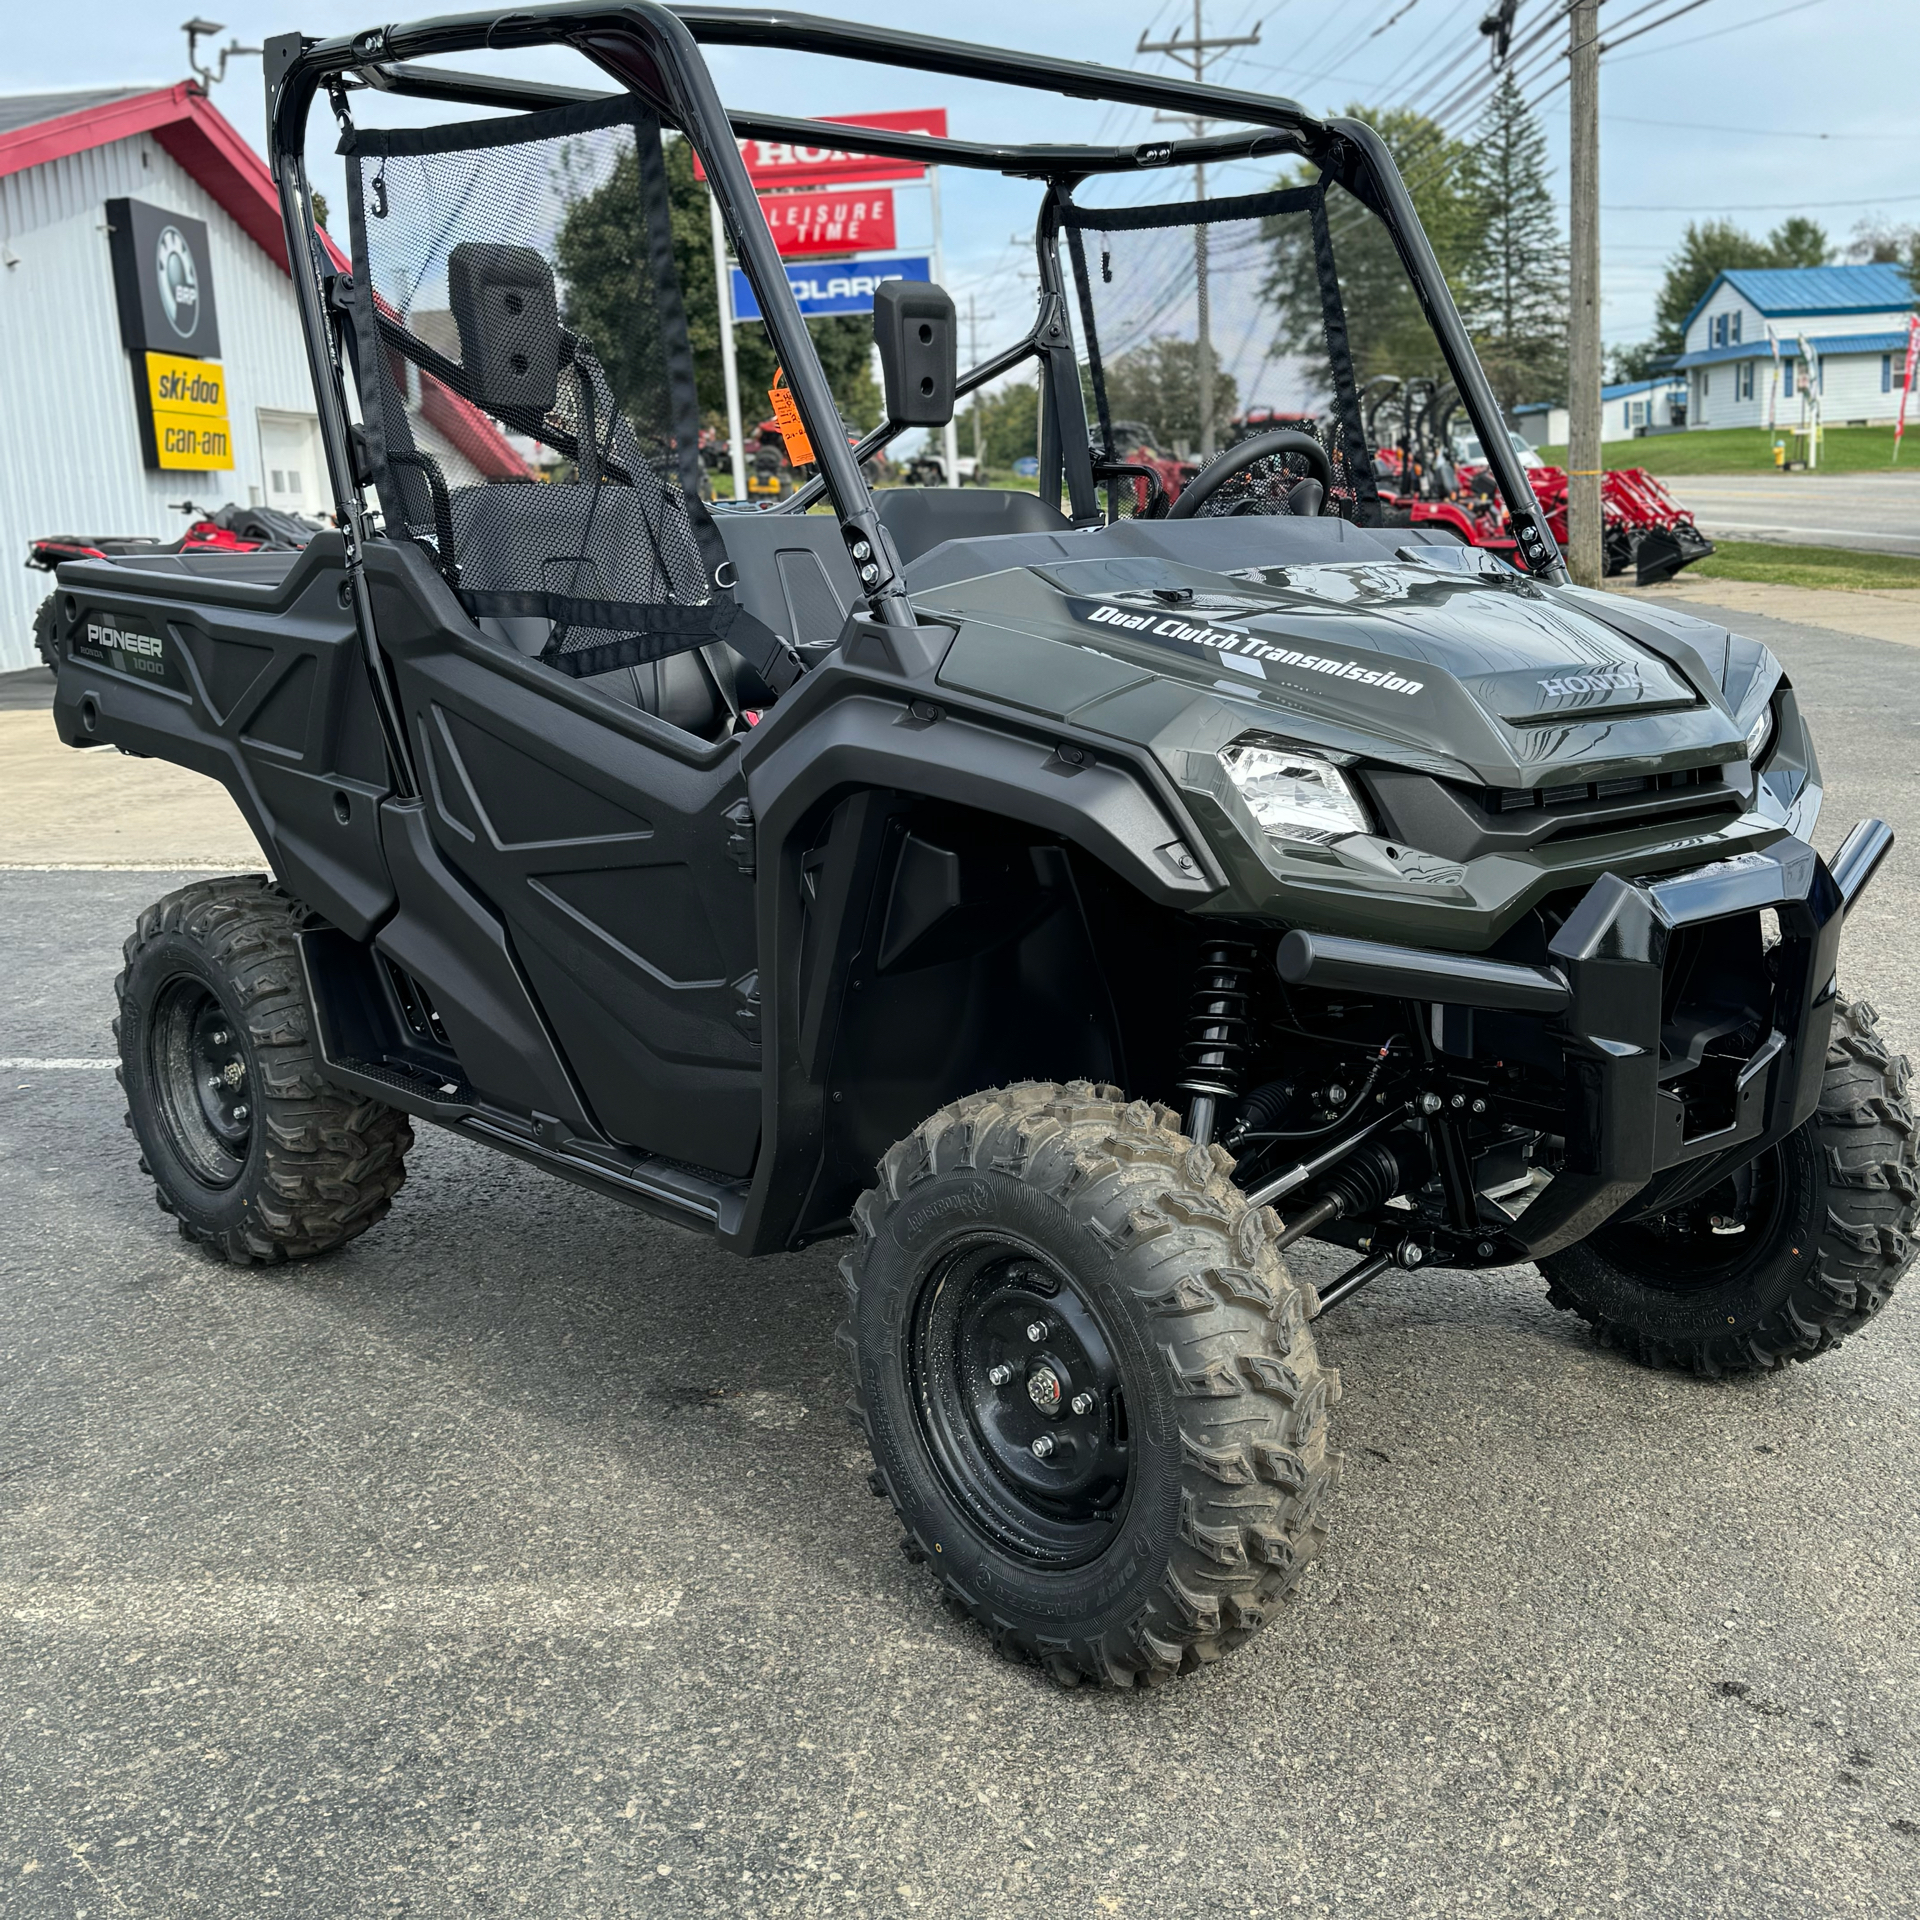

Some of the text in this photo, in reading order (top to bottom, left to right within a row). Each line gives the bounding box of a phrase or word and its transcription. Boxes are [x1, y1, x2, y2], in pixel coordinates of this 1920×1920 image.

[769, 201, 884, 227] LEISURE
[797, 221, 860, 243] TIME
[176, 285, 197, 305] BRP
[159, 369, 219, 405] ski-doo
[165, 427, 227, 457] can-am
[80, 646, 104, 659] HONDA
[87, 623, 163, 658] PIONEER
[1087, 605, 1424, 696] Dual Clutch Transmission
[132, 657, 165, 676] 1000
[1537, 672, 1653, 697] HONDA
